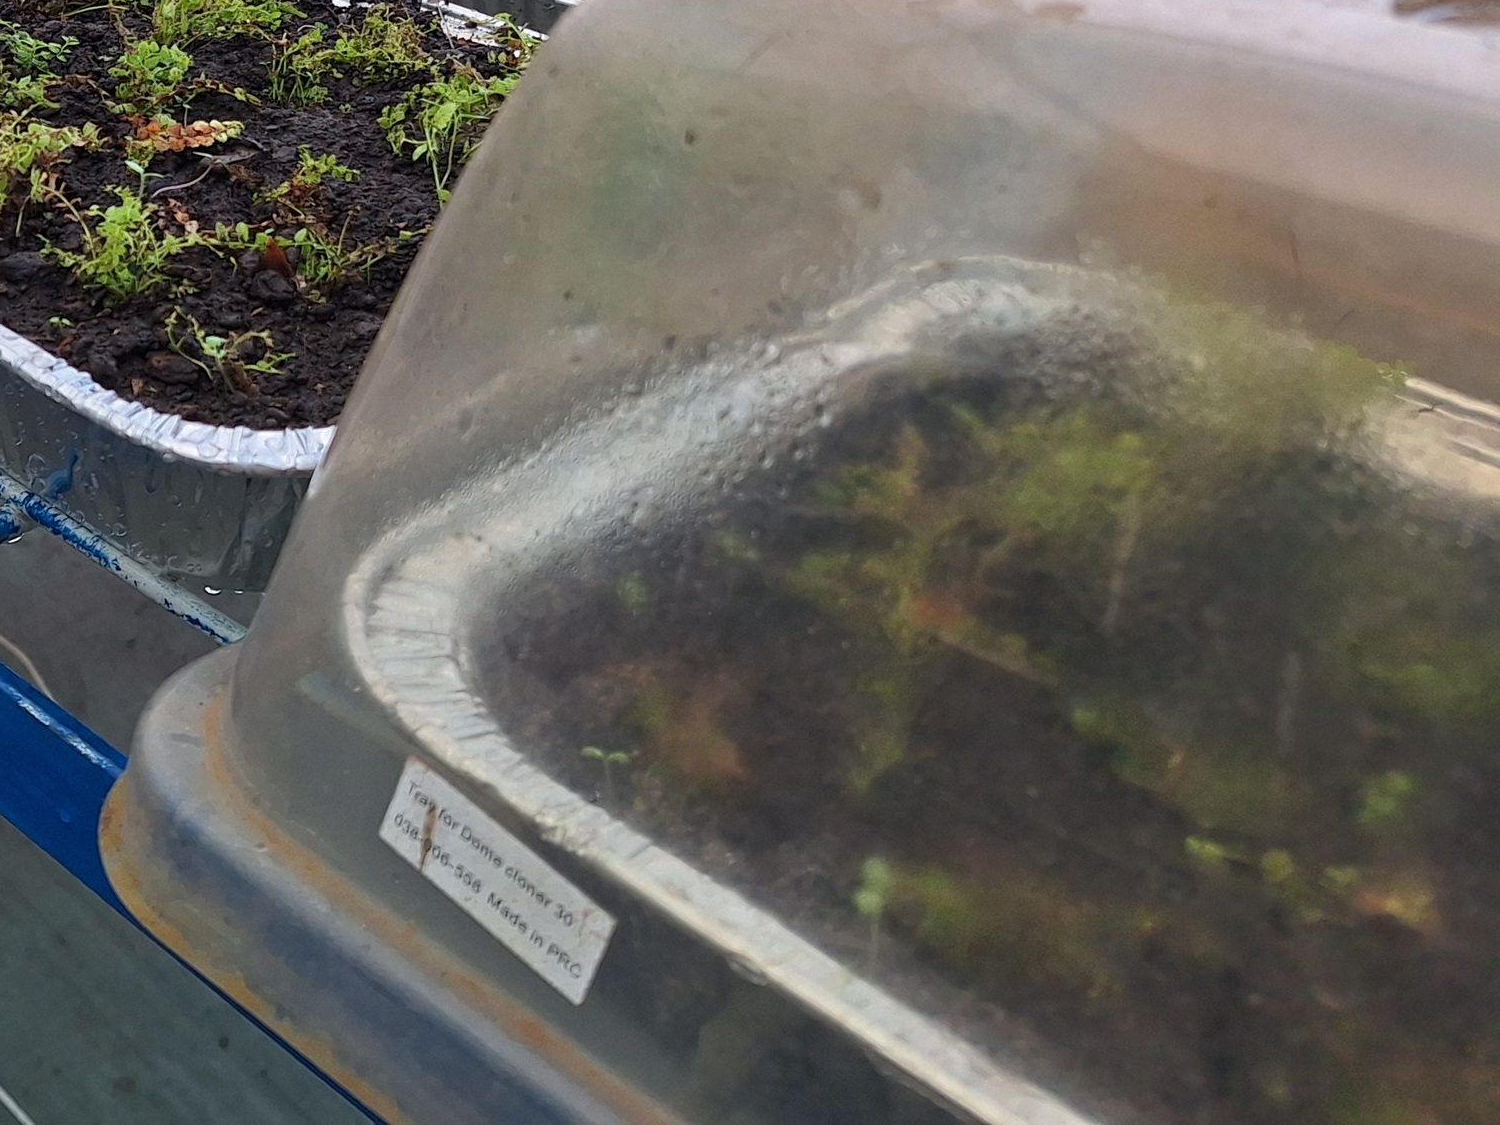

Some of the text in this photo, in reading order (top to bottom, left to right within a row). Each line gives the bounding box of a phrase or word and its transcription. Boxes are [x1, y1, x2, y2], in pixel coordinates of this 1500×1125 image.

[438, 807, 461, 831] for
[460, 824, 502, 868] Dome
[505, 865, 553, 909] cloner
[554, 903, 574, 928] 30
[486, 891, 528, 934] Made
[529, 928, 544, 948] in
[546, 941, 583, 980] PRC
